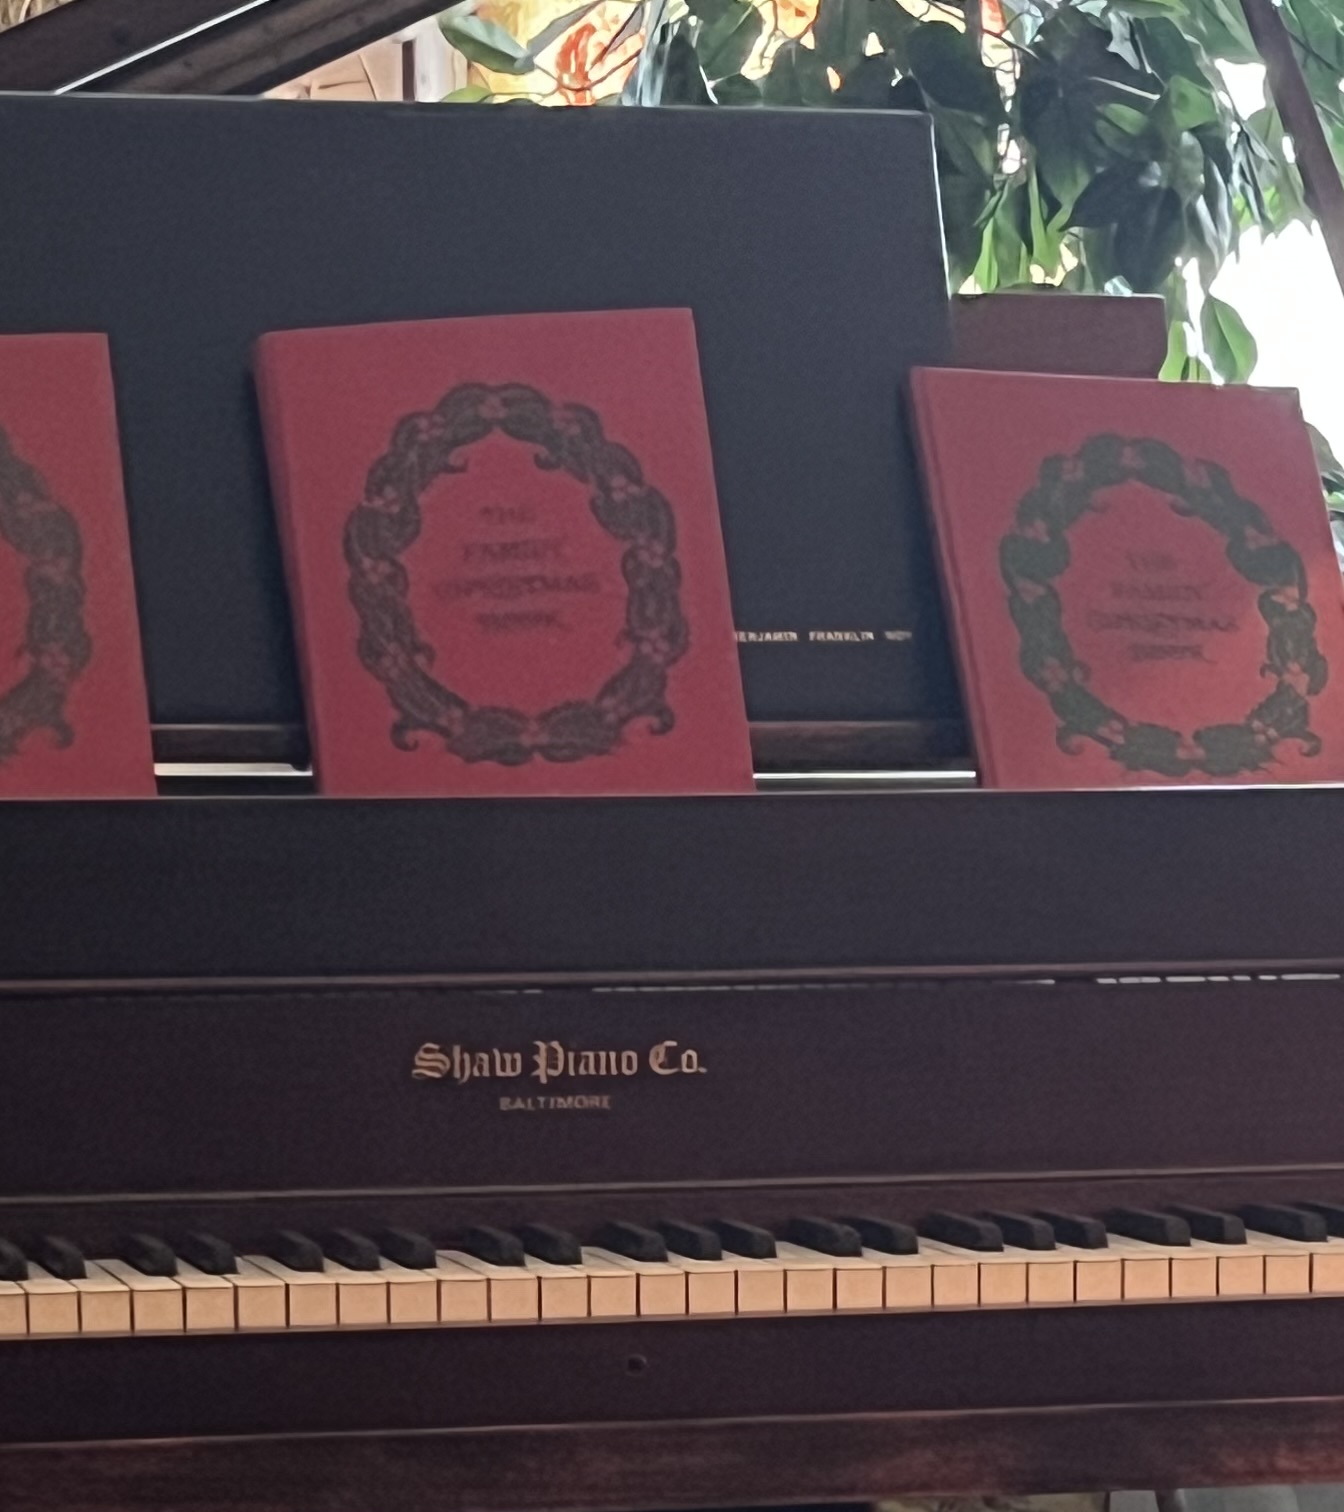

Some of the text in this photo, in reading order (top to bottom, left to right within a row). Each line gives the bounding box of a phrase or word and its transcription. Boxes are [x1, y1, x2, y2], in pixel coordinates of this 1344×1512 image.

[411, 1042, 523, 1084] Shaw
[530, 1040, 639, 1085] Piano
[498, 1095, 612, 1111] BALTIMORE
